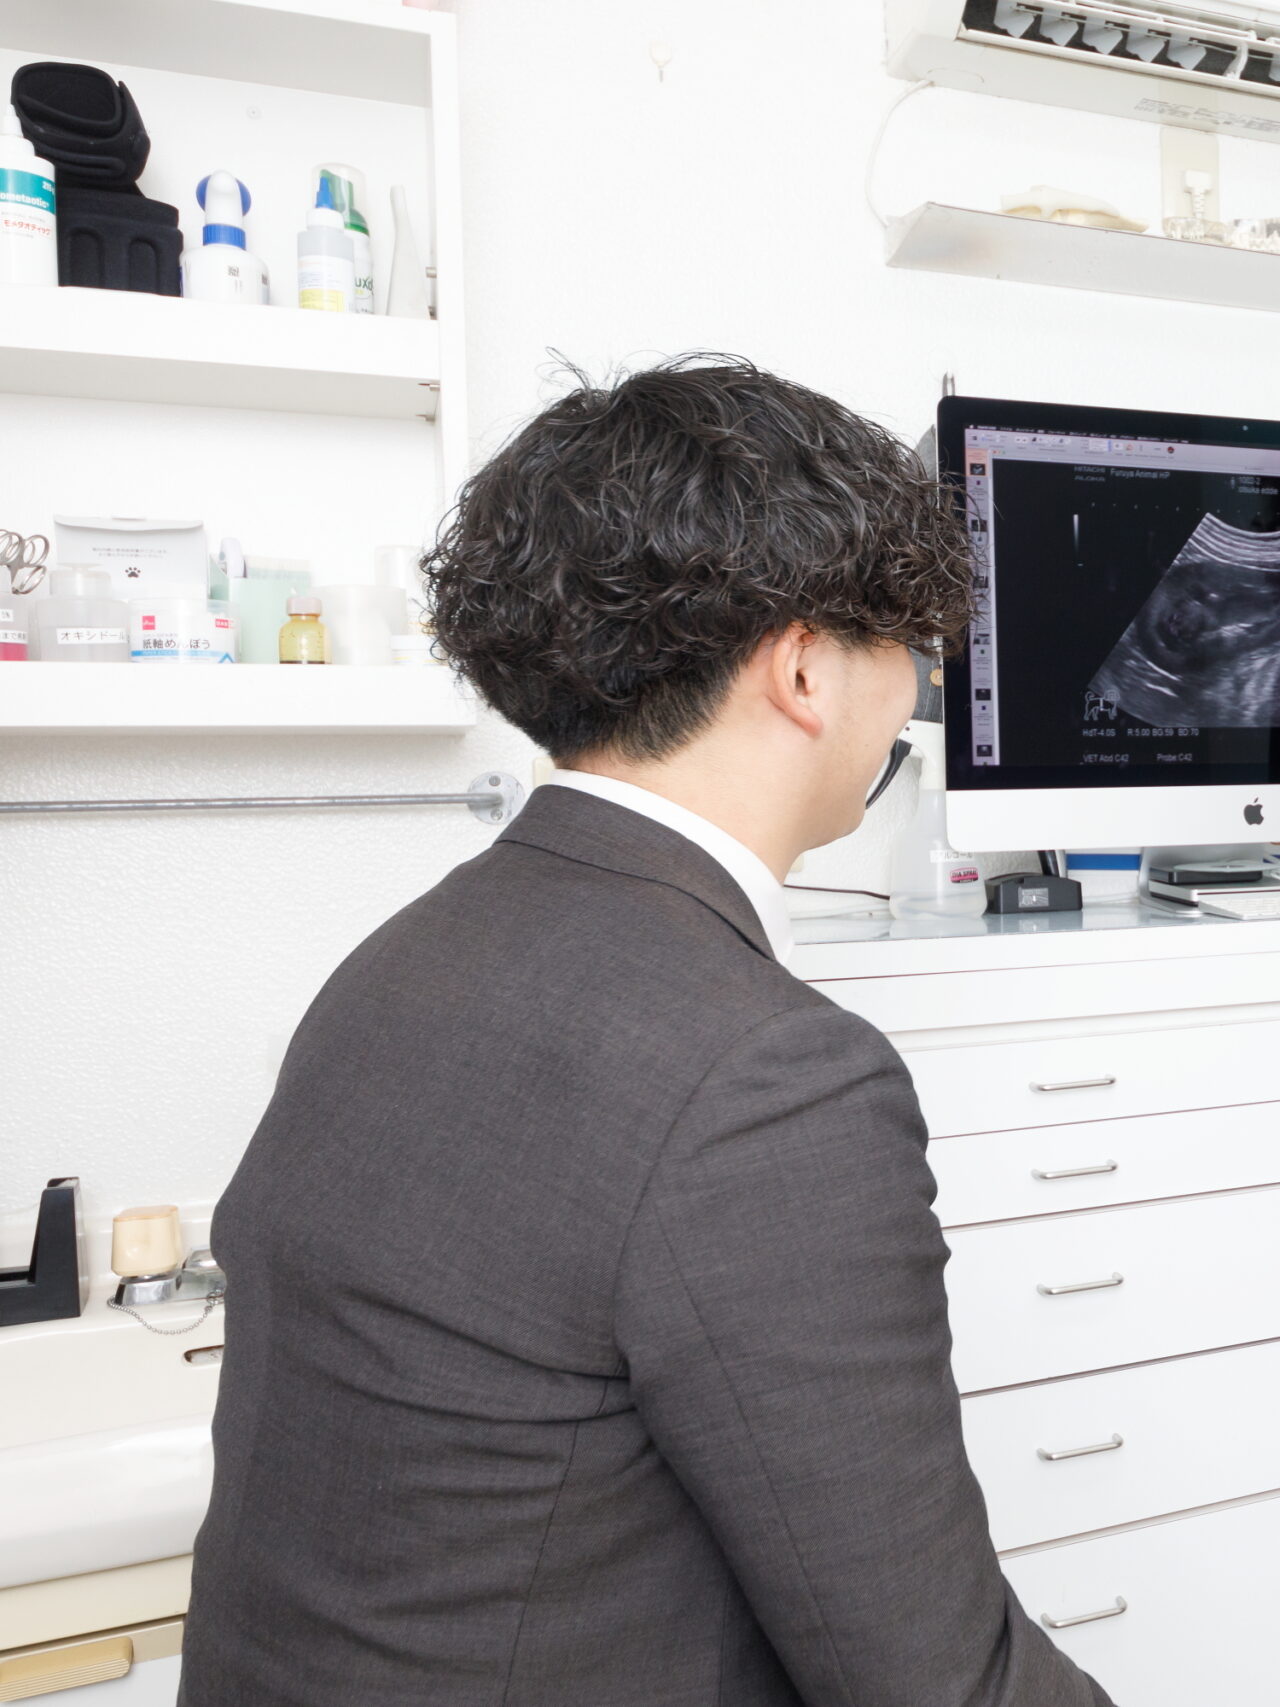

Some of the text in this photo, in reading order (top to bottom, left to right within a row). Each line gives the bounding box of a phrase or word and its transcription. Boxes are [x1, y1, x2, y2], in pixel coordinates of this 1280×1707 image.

[0, 192, 49, 209] ometaotic
[60, 631, 125, 641] オキシドール
